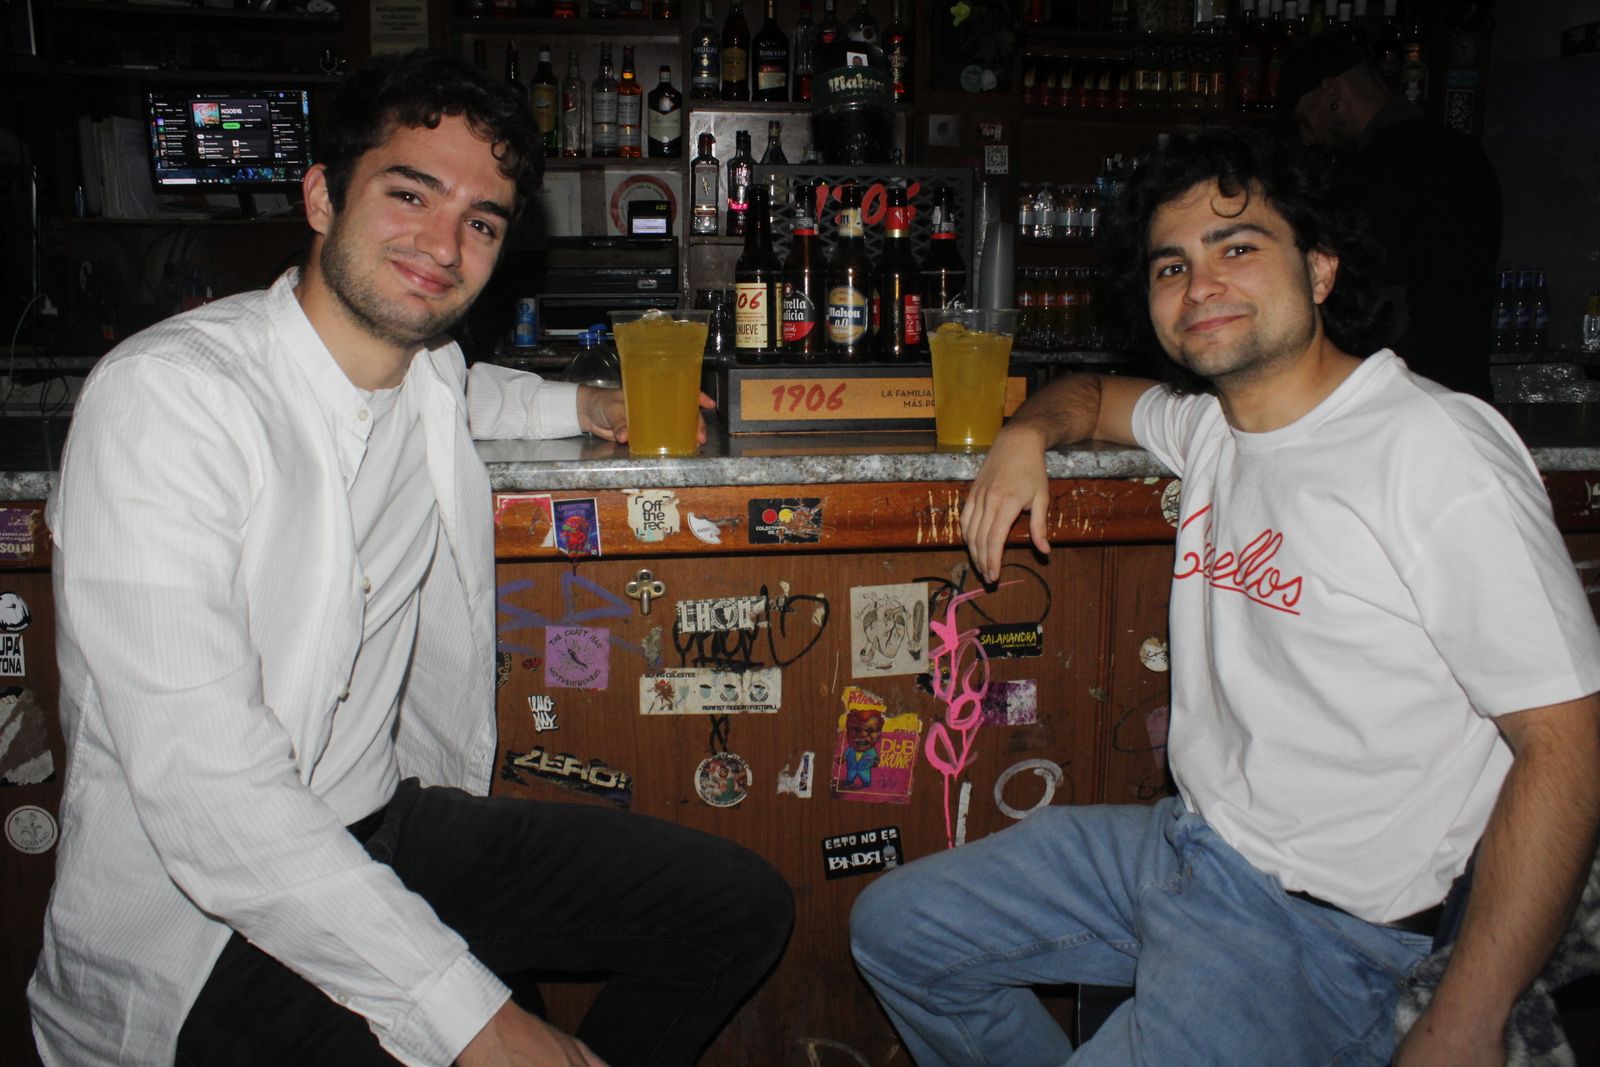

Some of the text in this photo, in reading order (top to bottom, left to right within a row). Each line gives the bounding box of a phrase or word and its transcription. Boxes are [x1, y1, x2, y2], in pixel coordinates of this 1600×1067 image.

[736, 291, 763, 309] 06
[783, 298, 807, 310] trella
[783, 309, 805, 321] alicia
[771, 383, 846, 412] 1906
[881, 388, 932, 398] LA FAMILIA
[925, 399, 936, 408] PR
[642, 499, 663, 512] Off
[642, 510, 665, 521] the
[548, 634, 563, 646] THE
[980, 631, 1037, 645] SALAMANDRA
[880, 738, 915, 754] DUB
[825, 828, 898, 849] ESTO NO ES
